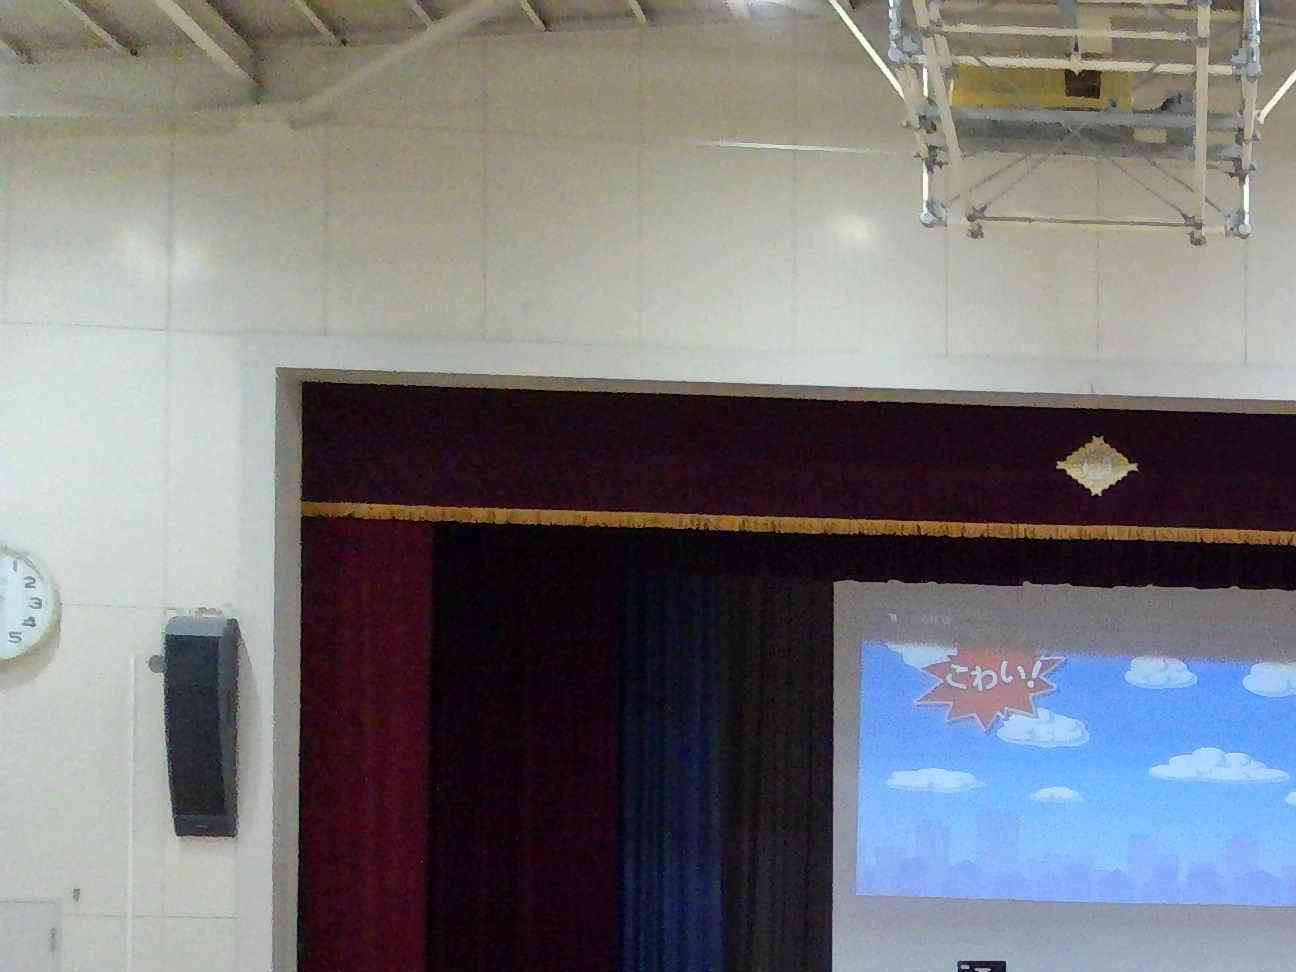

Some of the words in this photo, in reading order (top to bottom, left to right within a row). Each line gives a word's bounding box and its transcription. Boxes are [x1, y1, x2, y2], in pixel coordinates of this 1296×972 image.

[24, 576, 36, 589] 2
[30, 597, 43, 609] 3
[22, 617, 36, 628] 4
[8, 631, 23, 644] 5
